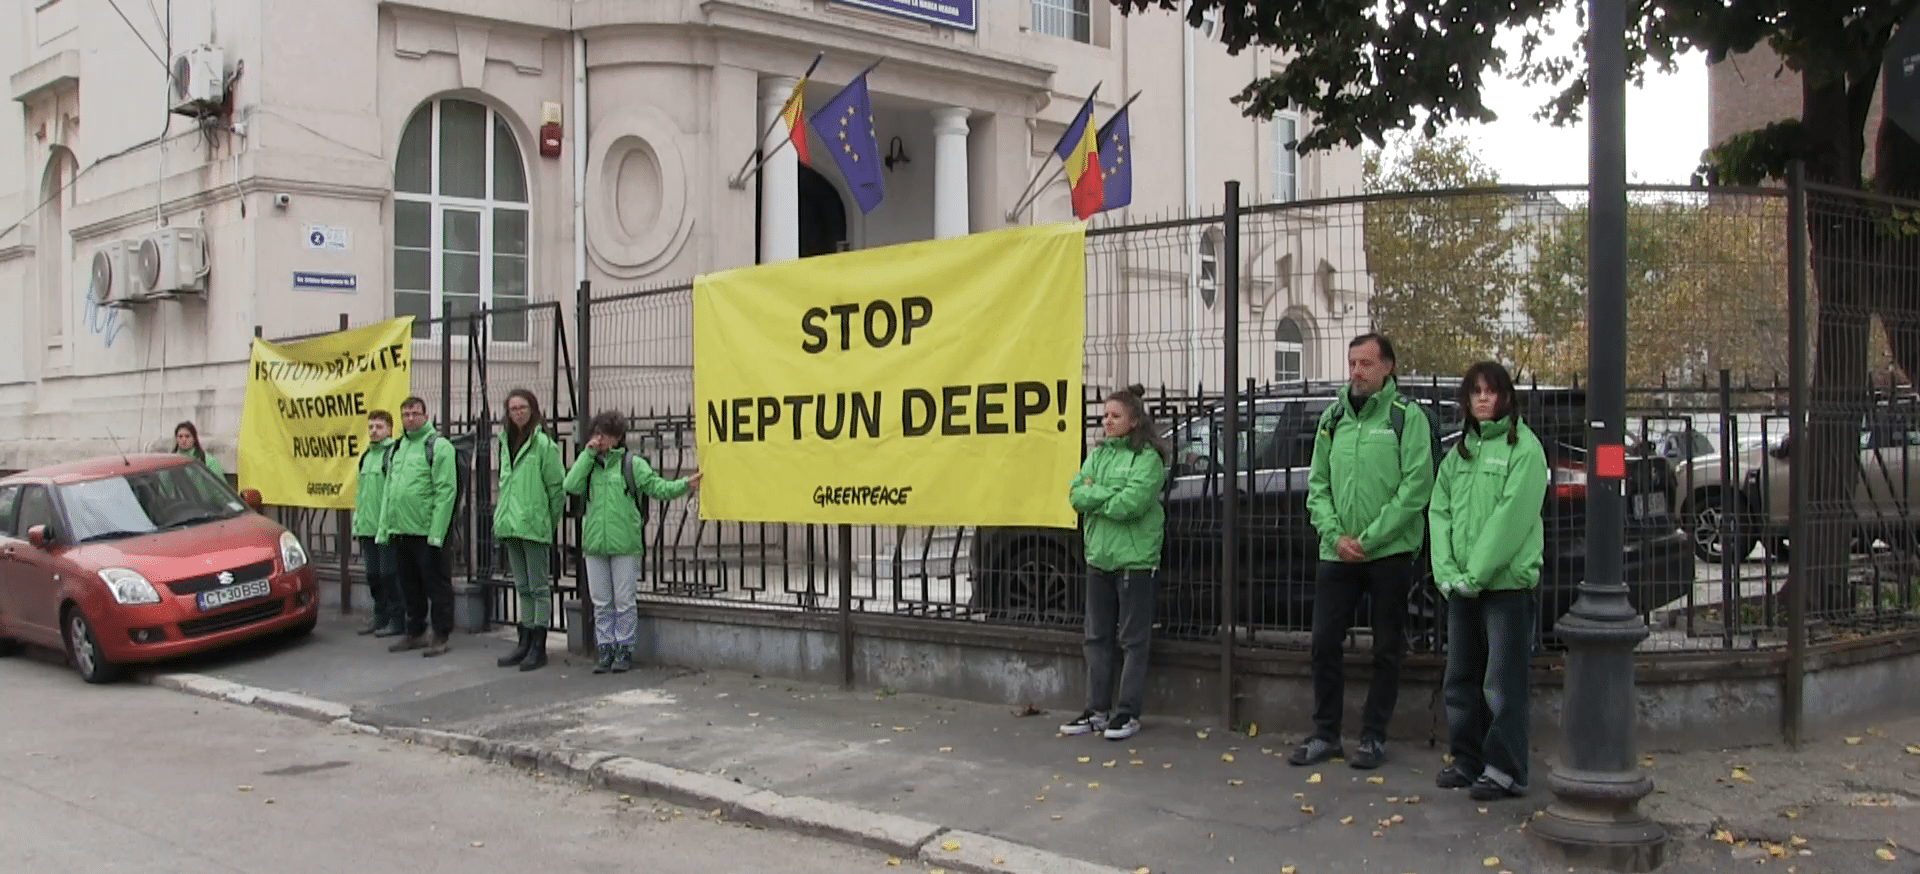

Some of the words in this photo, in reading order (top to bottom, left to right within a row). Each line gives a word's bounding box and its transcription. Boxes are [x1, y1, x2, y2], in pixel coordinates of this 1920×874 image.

[801, 296, 933, 354] STOP
[277, 392, 368, 419] PLATFORME
[707, 390, 882, 443] NEPTUN
[902, 379, 1069, 438] DEEP!
[293, 434, 361, 459] RUGINITE
[812, 485, 913, 508] GREENPEACE
